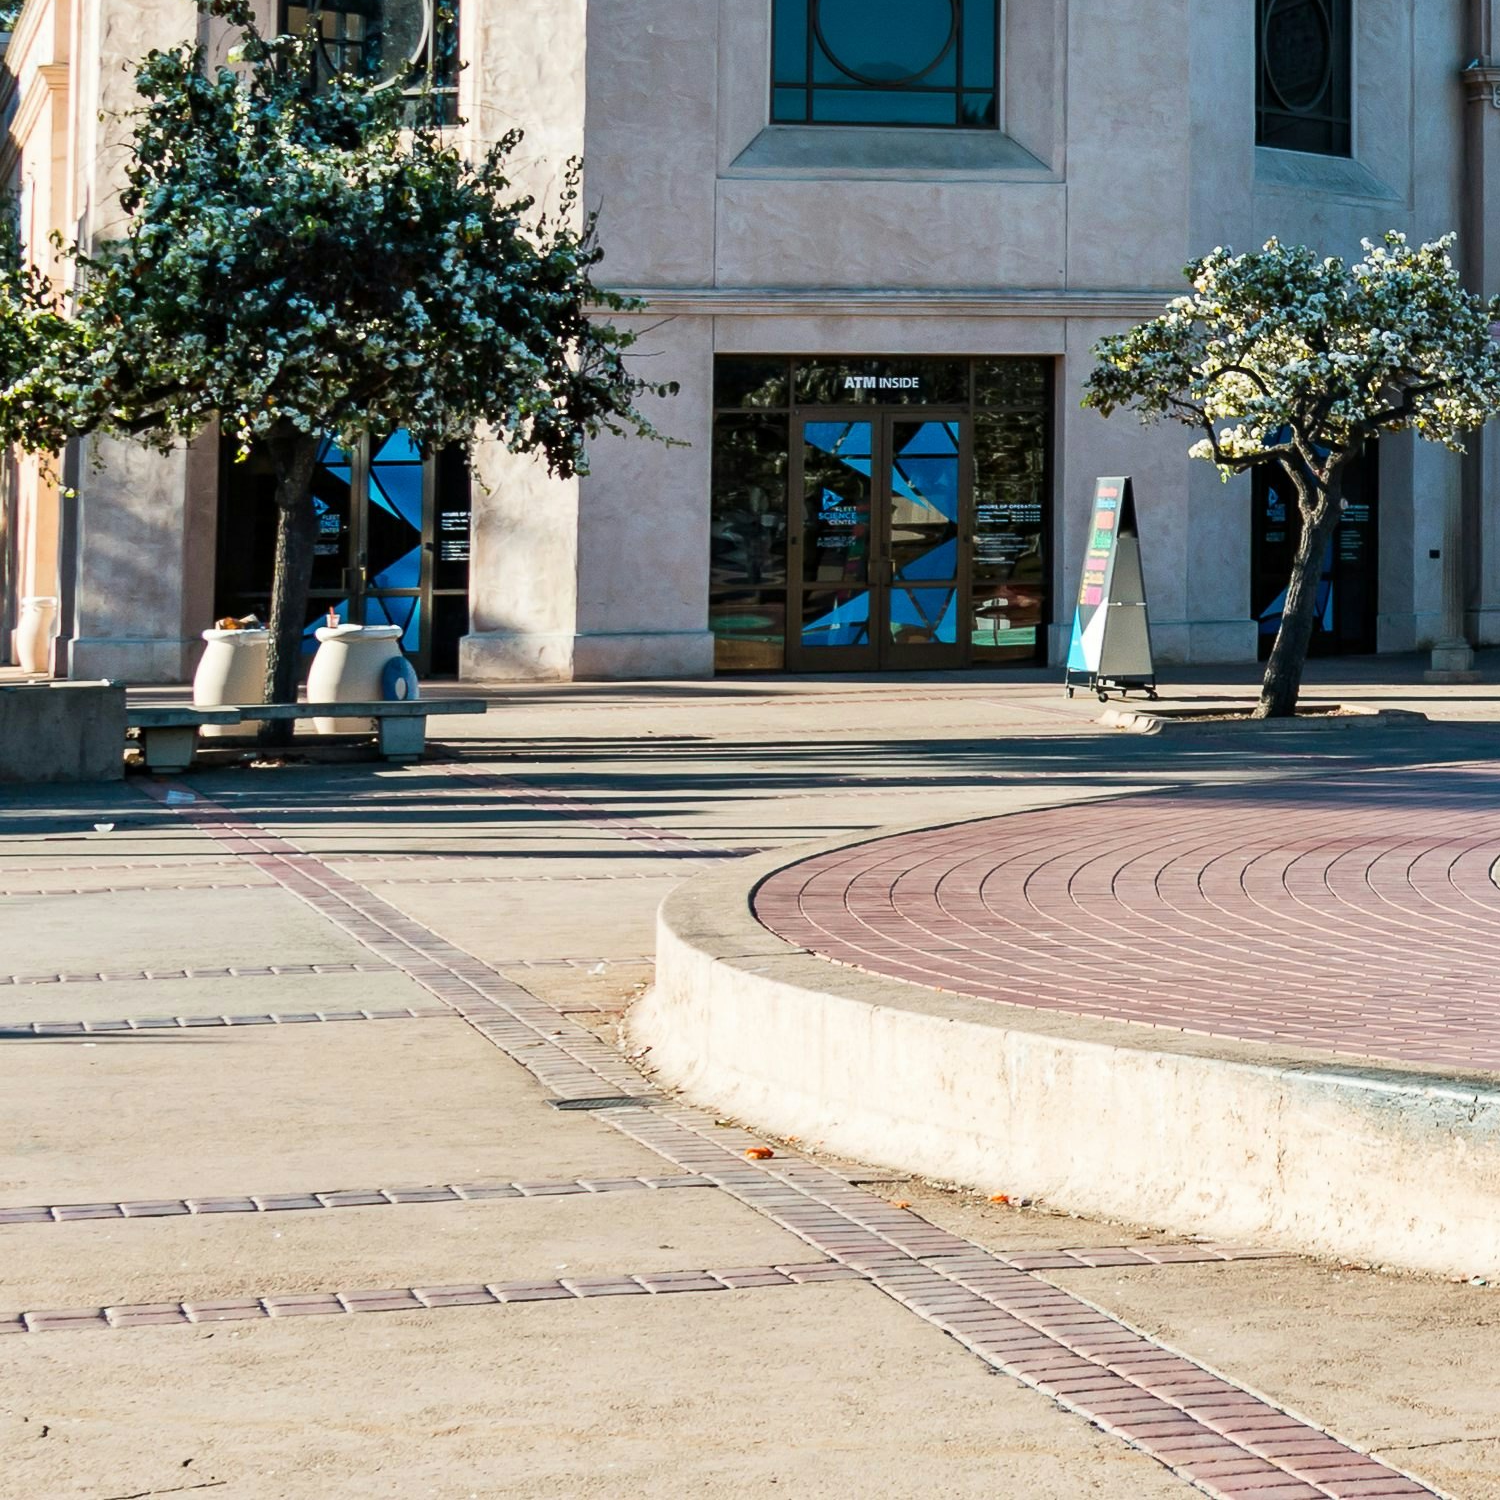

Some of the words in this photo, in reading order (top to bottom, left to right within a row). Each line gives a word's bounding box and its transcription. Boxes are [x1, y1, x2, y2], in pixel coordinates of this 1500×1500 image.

[844, 376, 876, 389] ATM
[879, 377, 920, 389] INSIDE
[818, 512, 857, 520] SCIENCE
